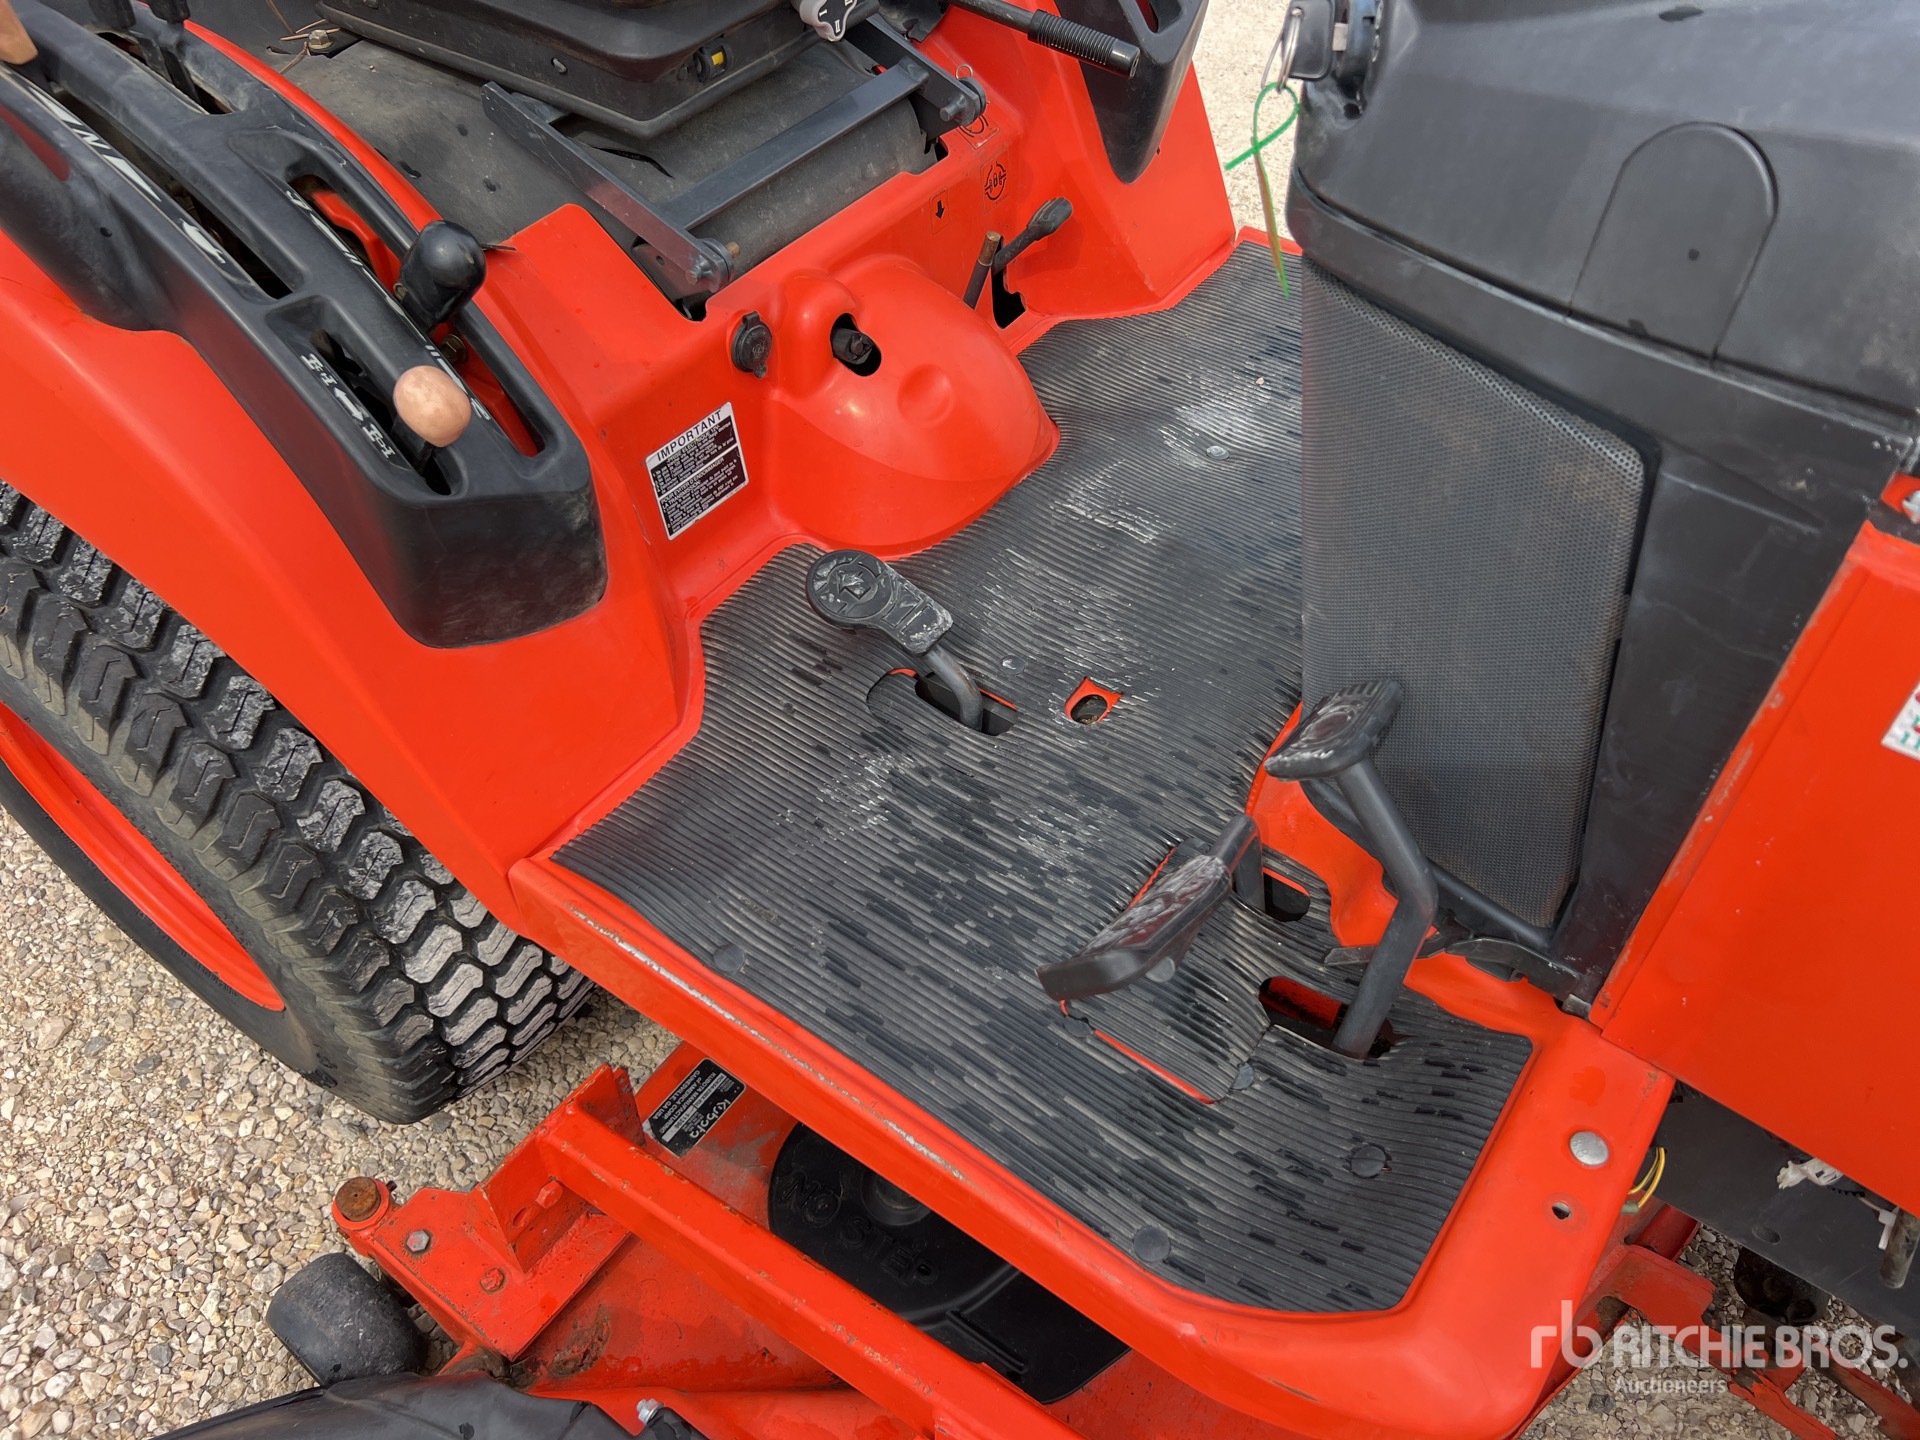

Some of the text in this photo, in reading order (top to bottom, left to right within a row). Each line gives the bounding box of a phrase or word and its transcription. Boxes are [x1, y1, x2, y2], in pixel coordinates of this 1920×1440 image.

[656, 410, 721, 462] IMPORTANT
[675, 1081, 698, 1105] AMERICA
[695, 1071, 717, 1092] KUBOTA
[652, 1107, 665, 1120] USA
[658, 1090, 699, 1133] MANUFACTURING
[662, 1100, 672, 1110] GA
[688, 1098, 731, 1139] Kubota
[782, 1170, 939, 1286] NO STEP
